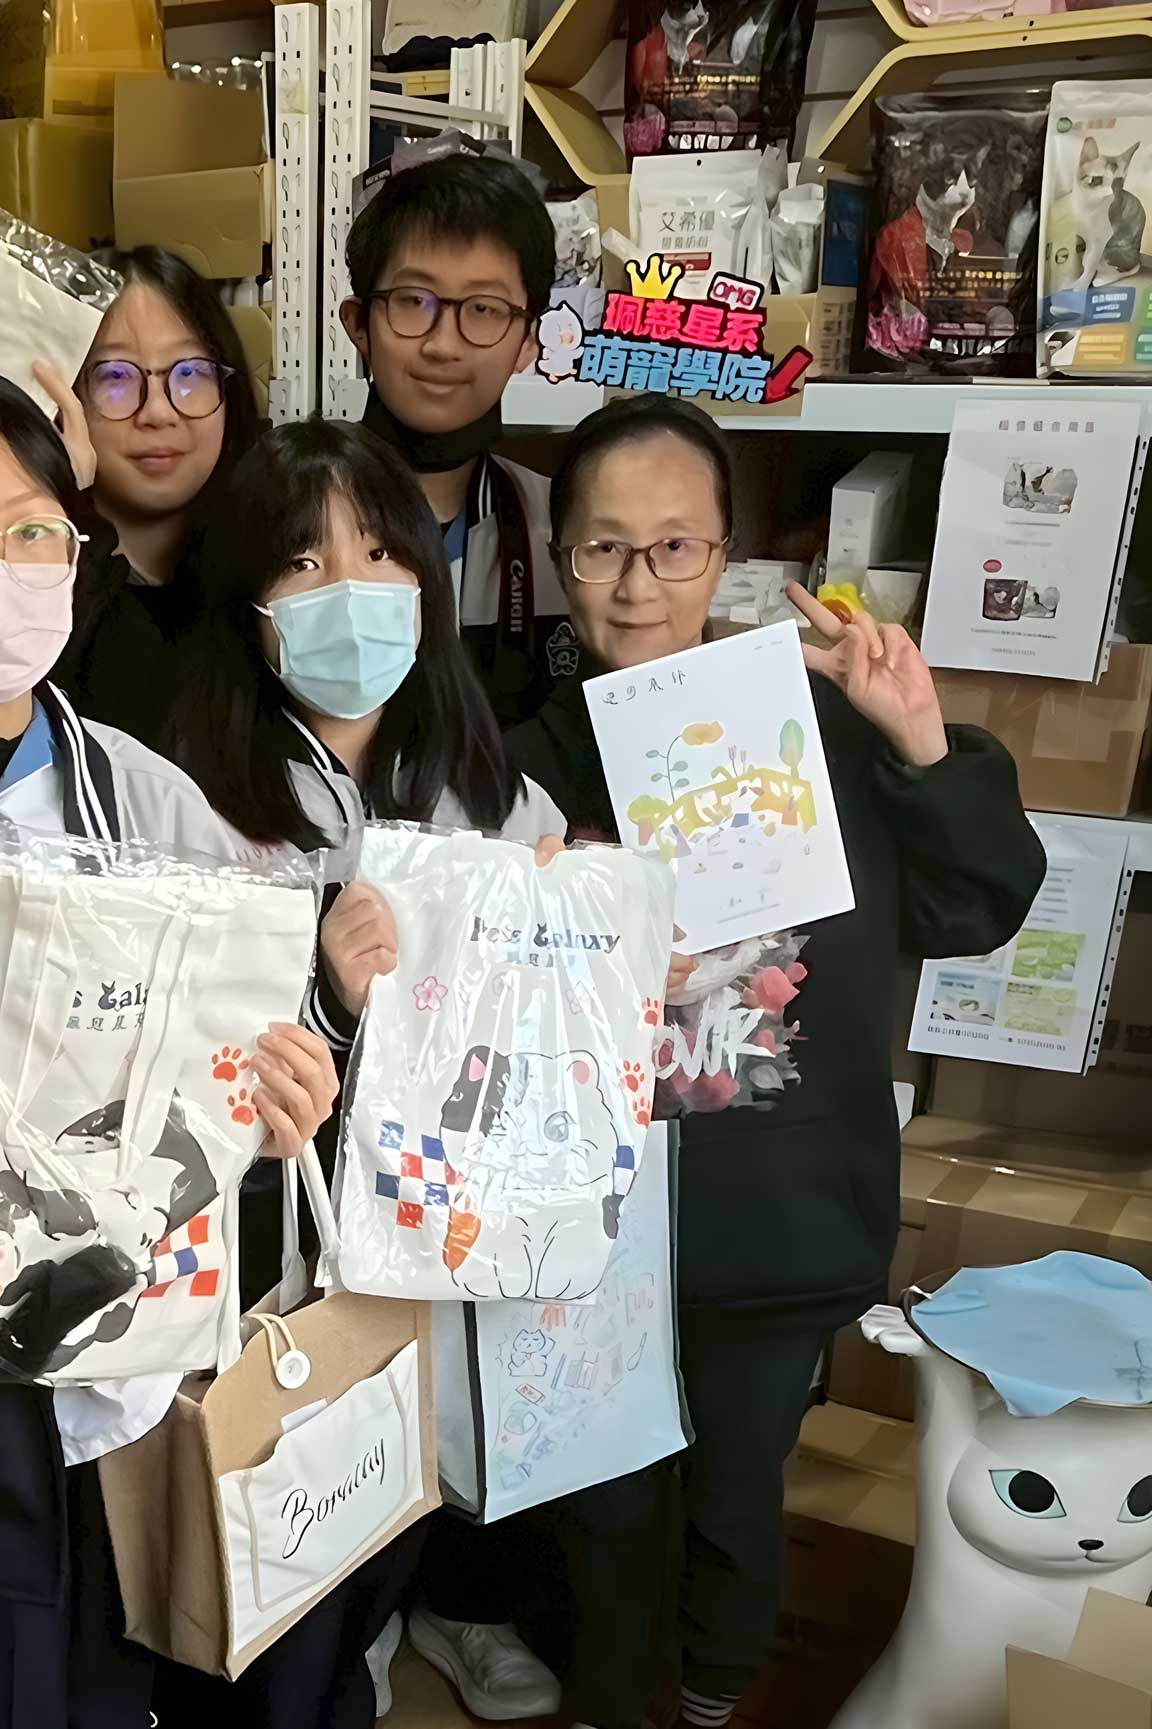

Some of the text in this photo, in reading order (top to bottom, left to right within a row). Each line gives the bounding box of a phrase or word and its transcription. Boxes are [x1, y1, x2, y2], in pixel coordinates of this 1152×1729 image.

[712, 281, 757, 307] OMG
[579, 334, 772, 404] 萌寵學院
